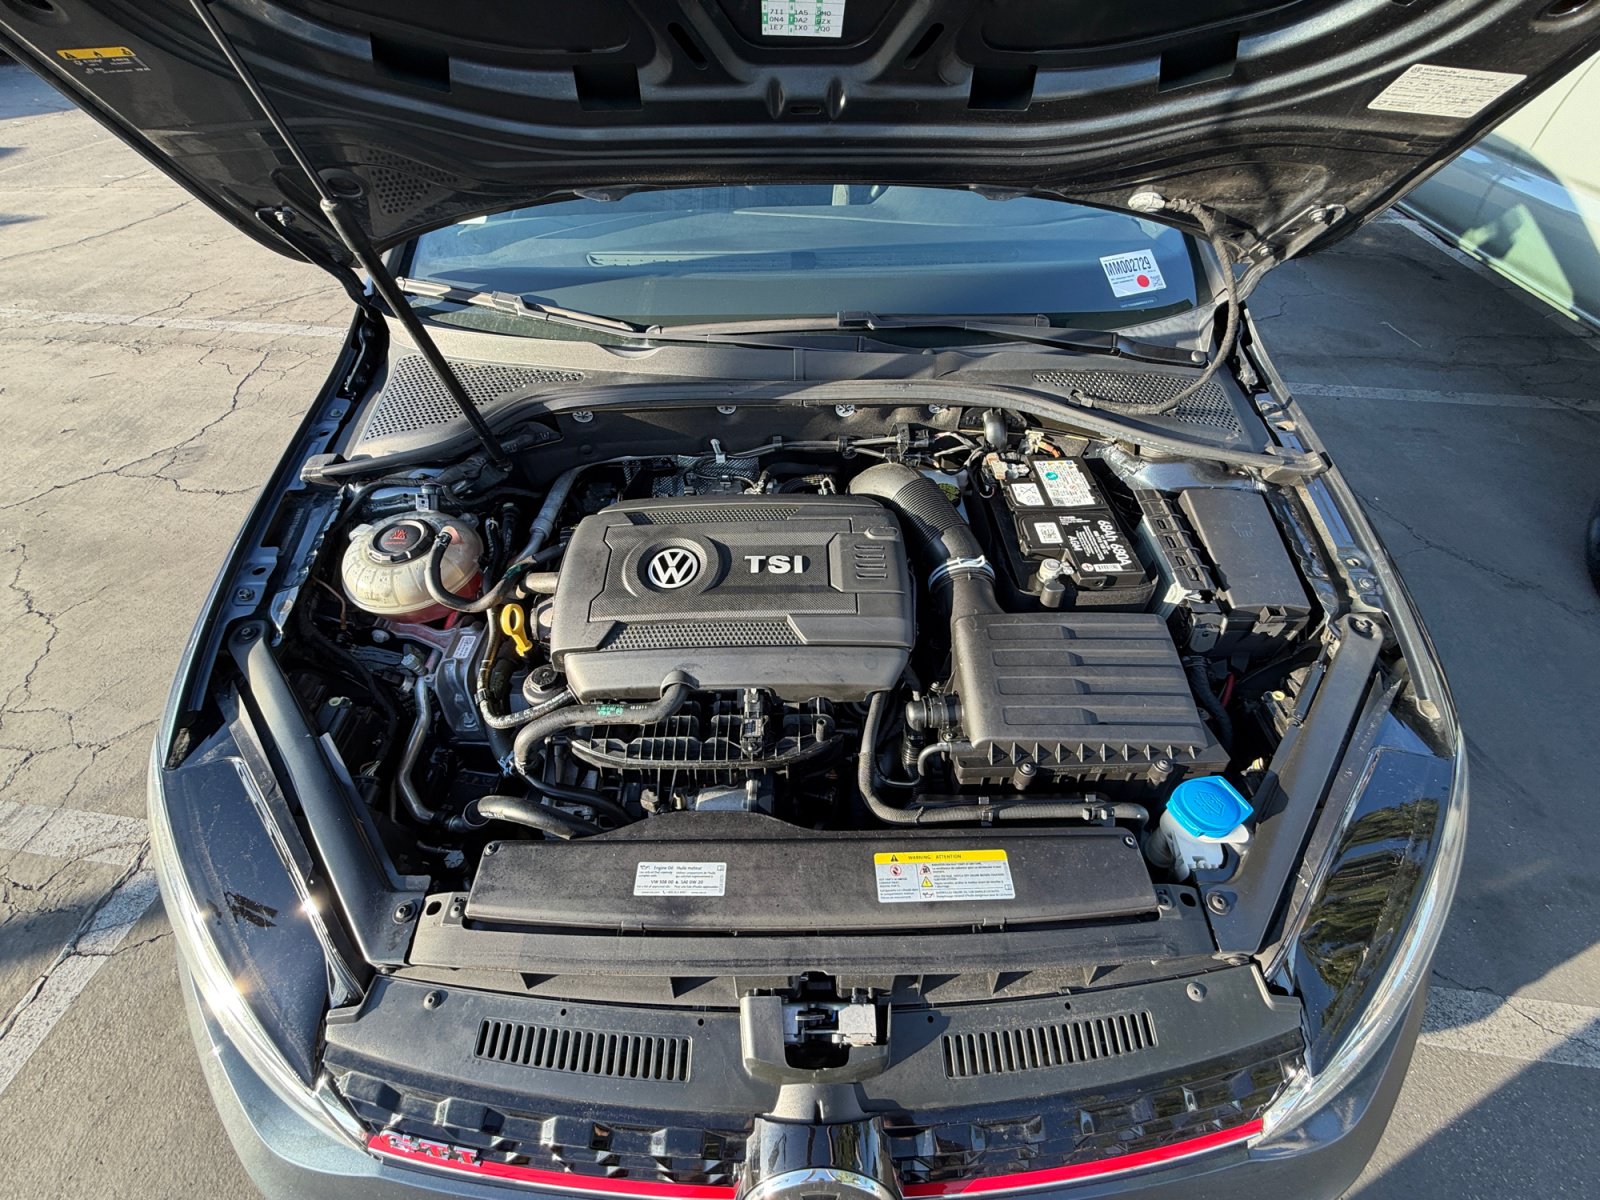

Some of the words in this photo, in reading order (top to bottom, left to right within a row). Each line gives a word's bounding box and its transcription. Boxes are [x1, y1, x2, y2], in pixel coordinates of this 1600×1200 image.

[1104, 256, 1152, 276] MM002729
[1067, 535, 1083, 551] AGM
[1097, 520, 1118, 542] 68Ah
[1110, 543, 1132, 566] 680A
[744, 555, 803, 574] TSI
